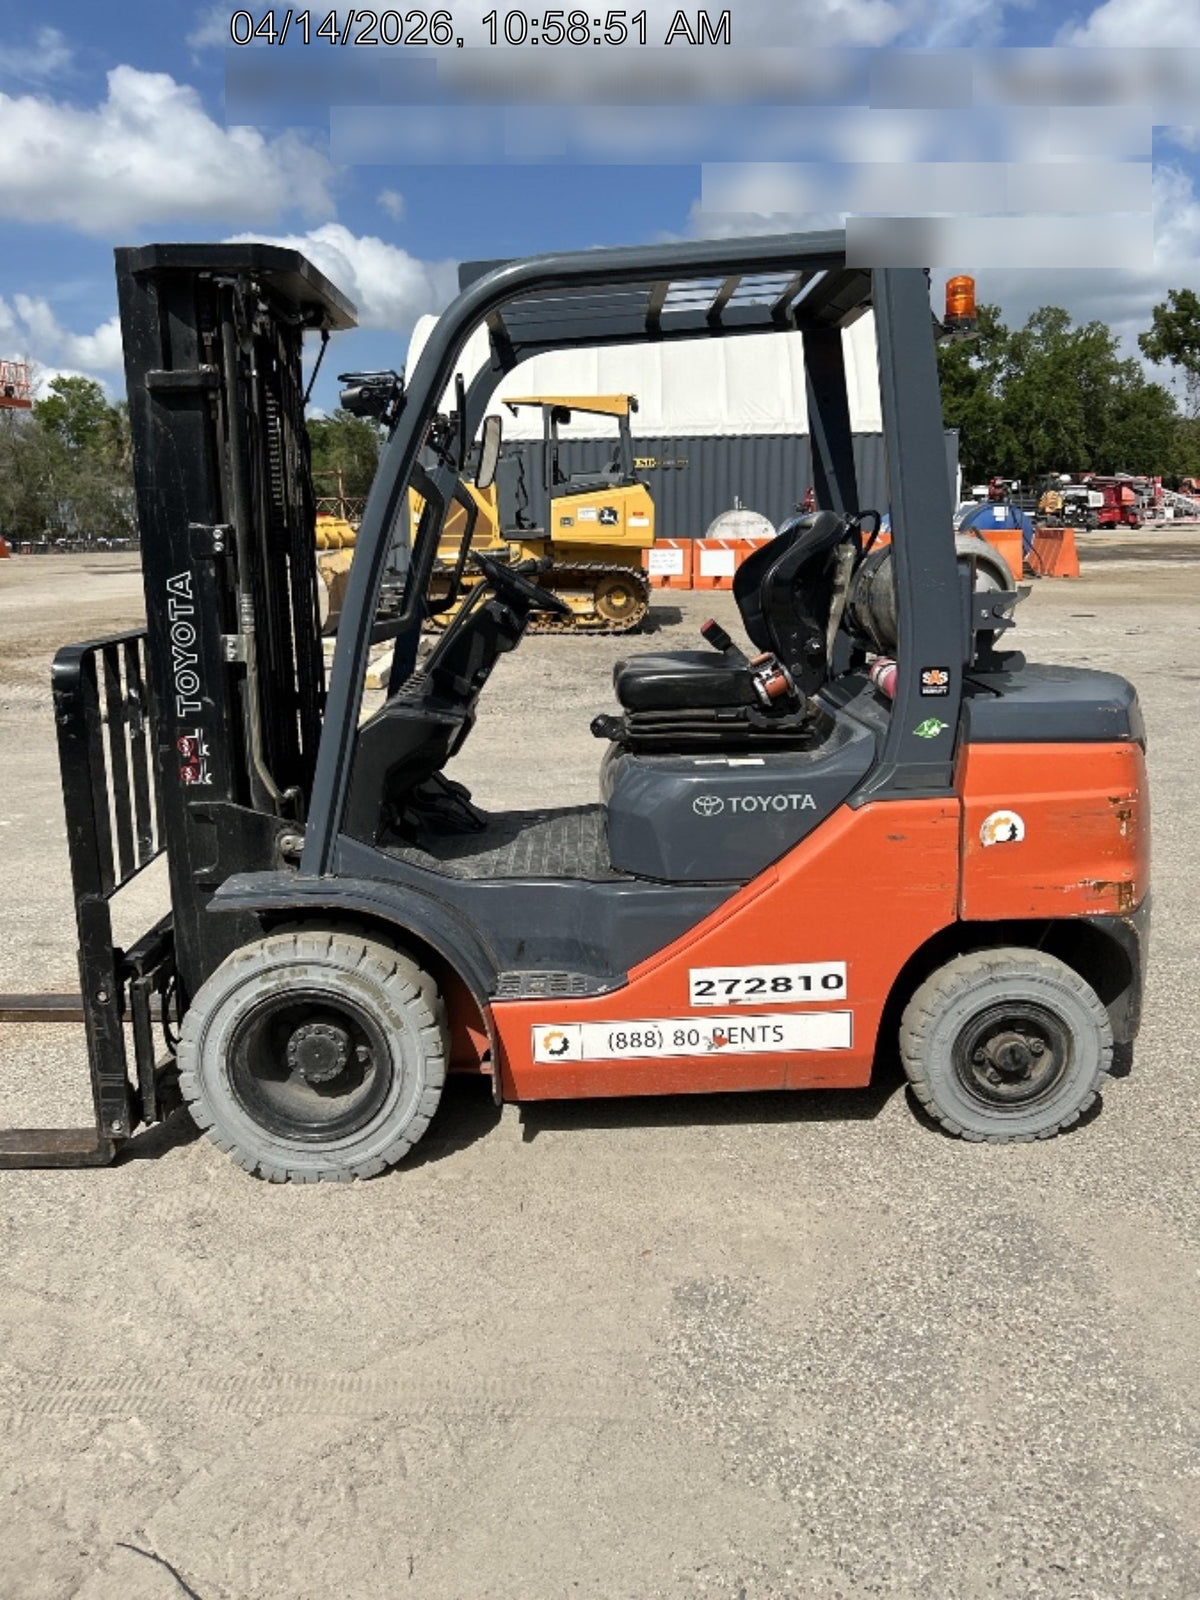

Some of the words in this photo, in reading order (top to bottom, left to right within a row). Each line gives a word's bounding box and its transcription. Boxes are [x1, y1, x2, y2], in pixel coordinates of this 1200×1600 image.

[166, 570, 202, 717] TOYOTA
[727, 794, 817, 813] TOYOTA
[694, 974, 844, 996] 272810
[608, 1030, 664, 1051] (888)
